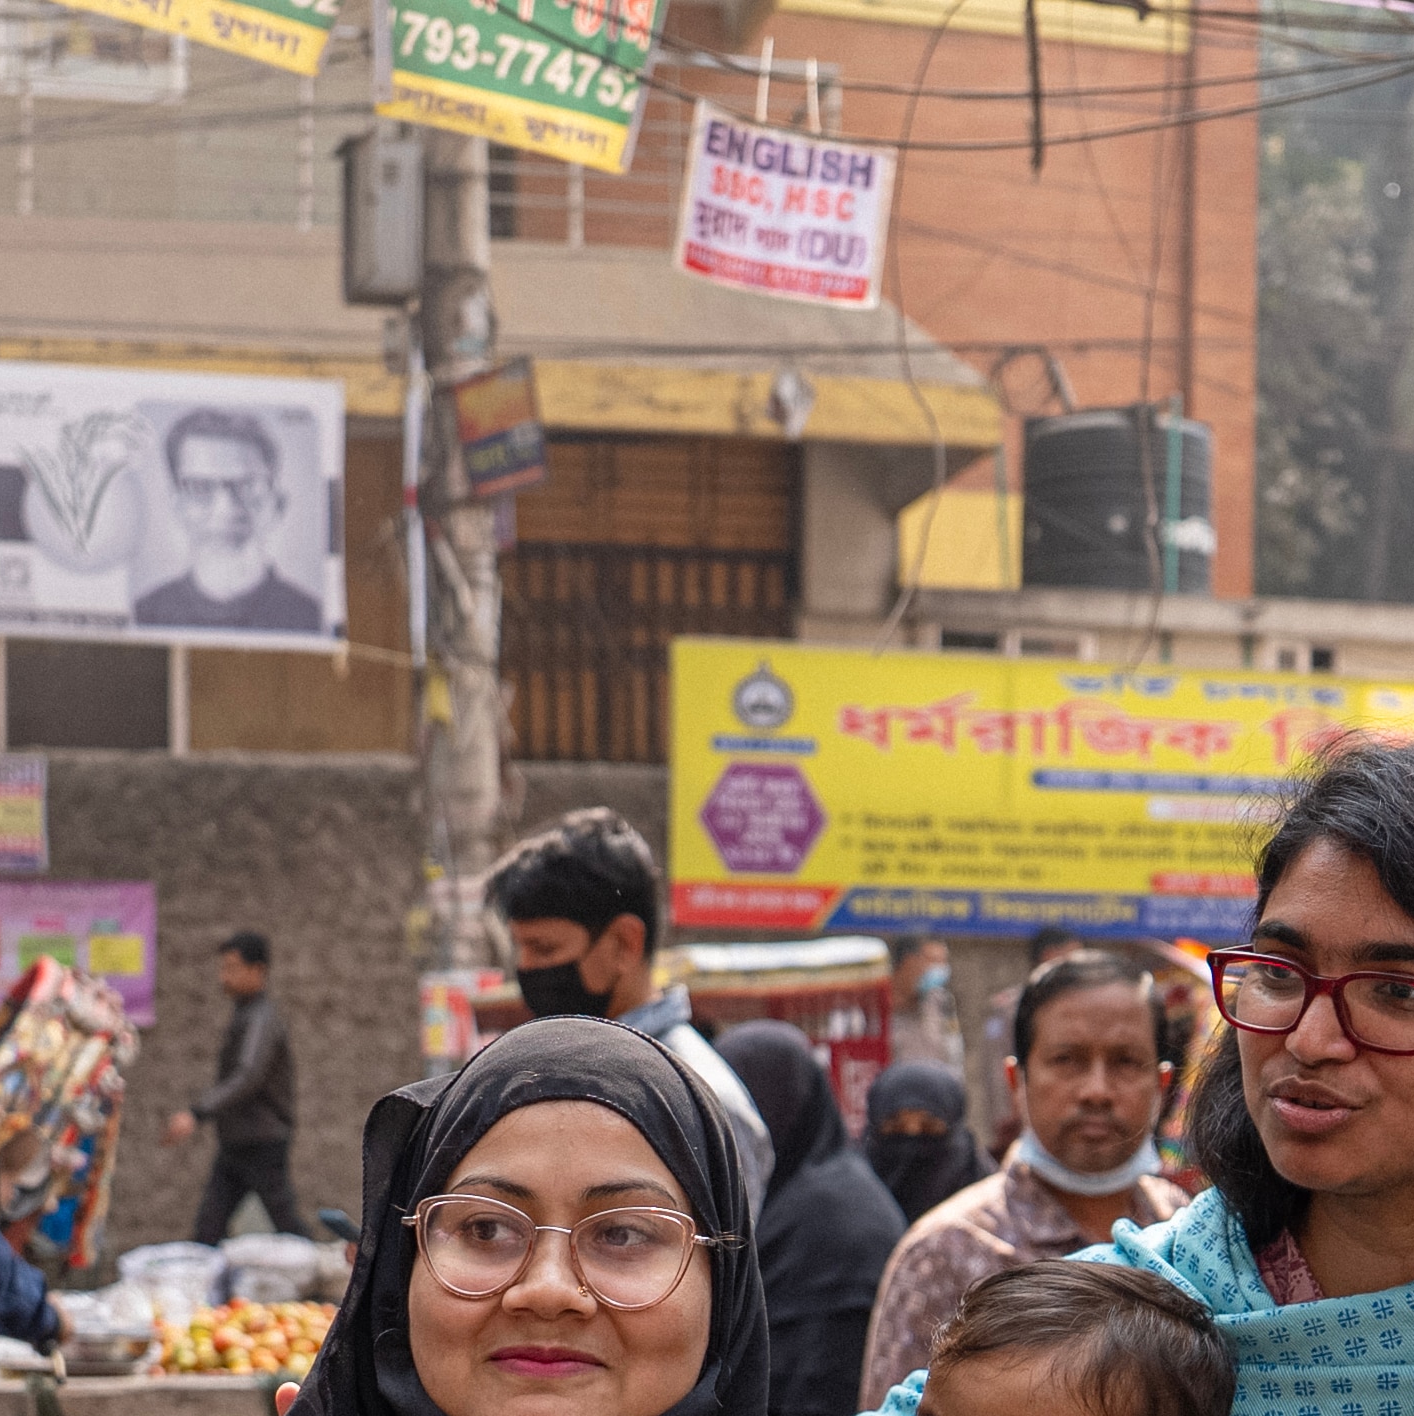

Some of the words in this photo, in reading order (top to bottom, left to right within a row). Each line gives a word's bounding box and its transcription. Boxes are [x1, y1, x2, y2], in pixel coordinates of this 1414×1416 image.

[706, 119, 875, 190] ENGLISH
[782, 184, 855, 223] HSC
[796, 227, 867, 270] (DU)
[837, 690, 1241, 763] ধর্মরাজিক
